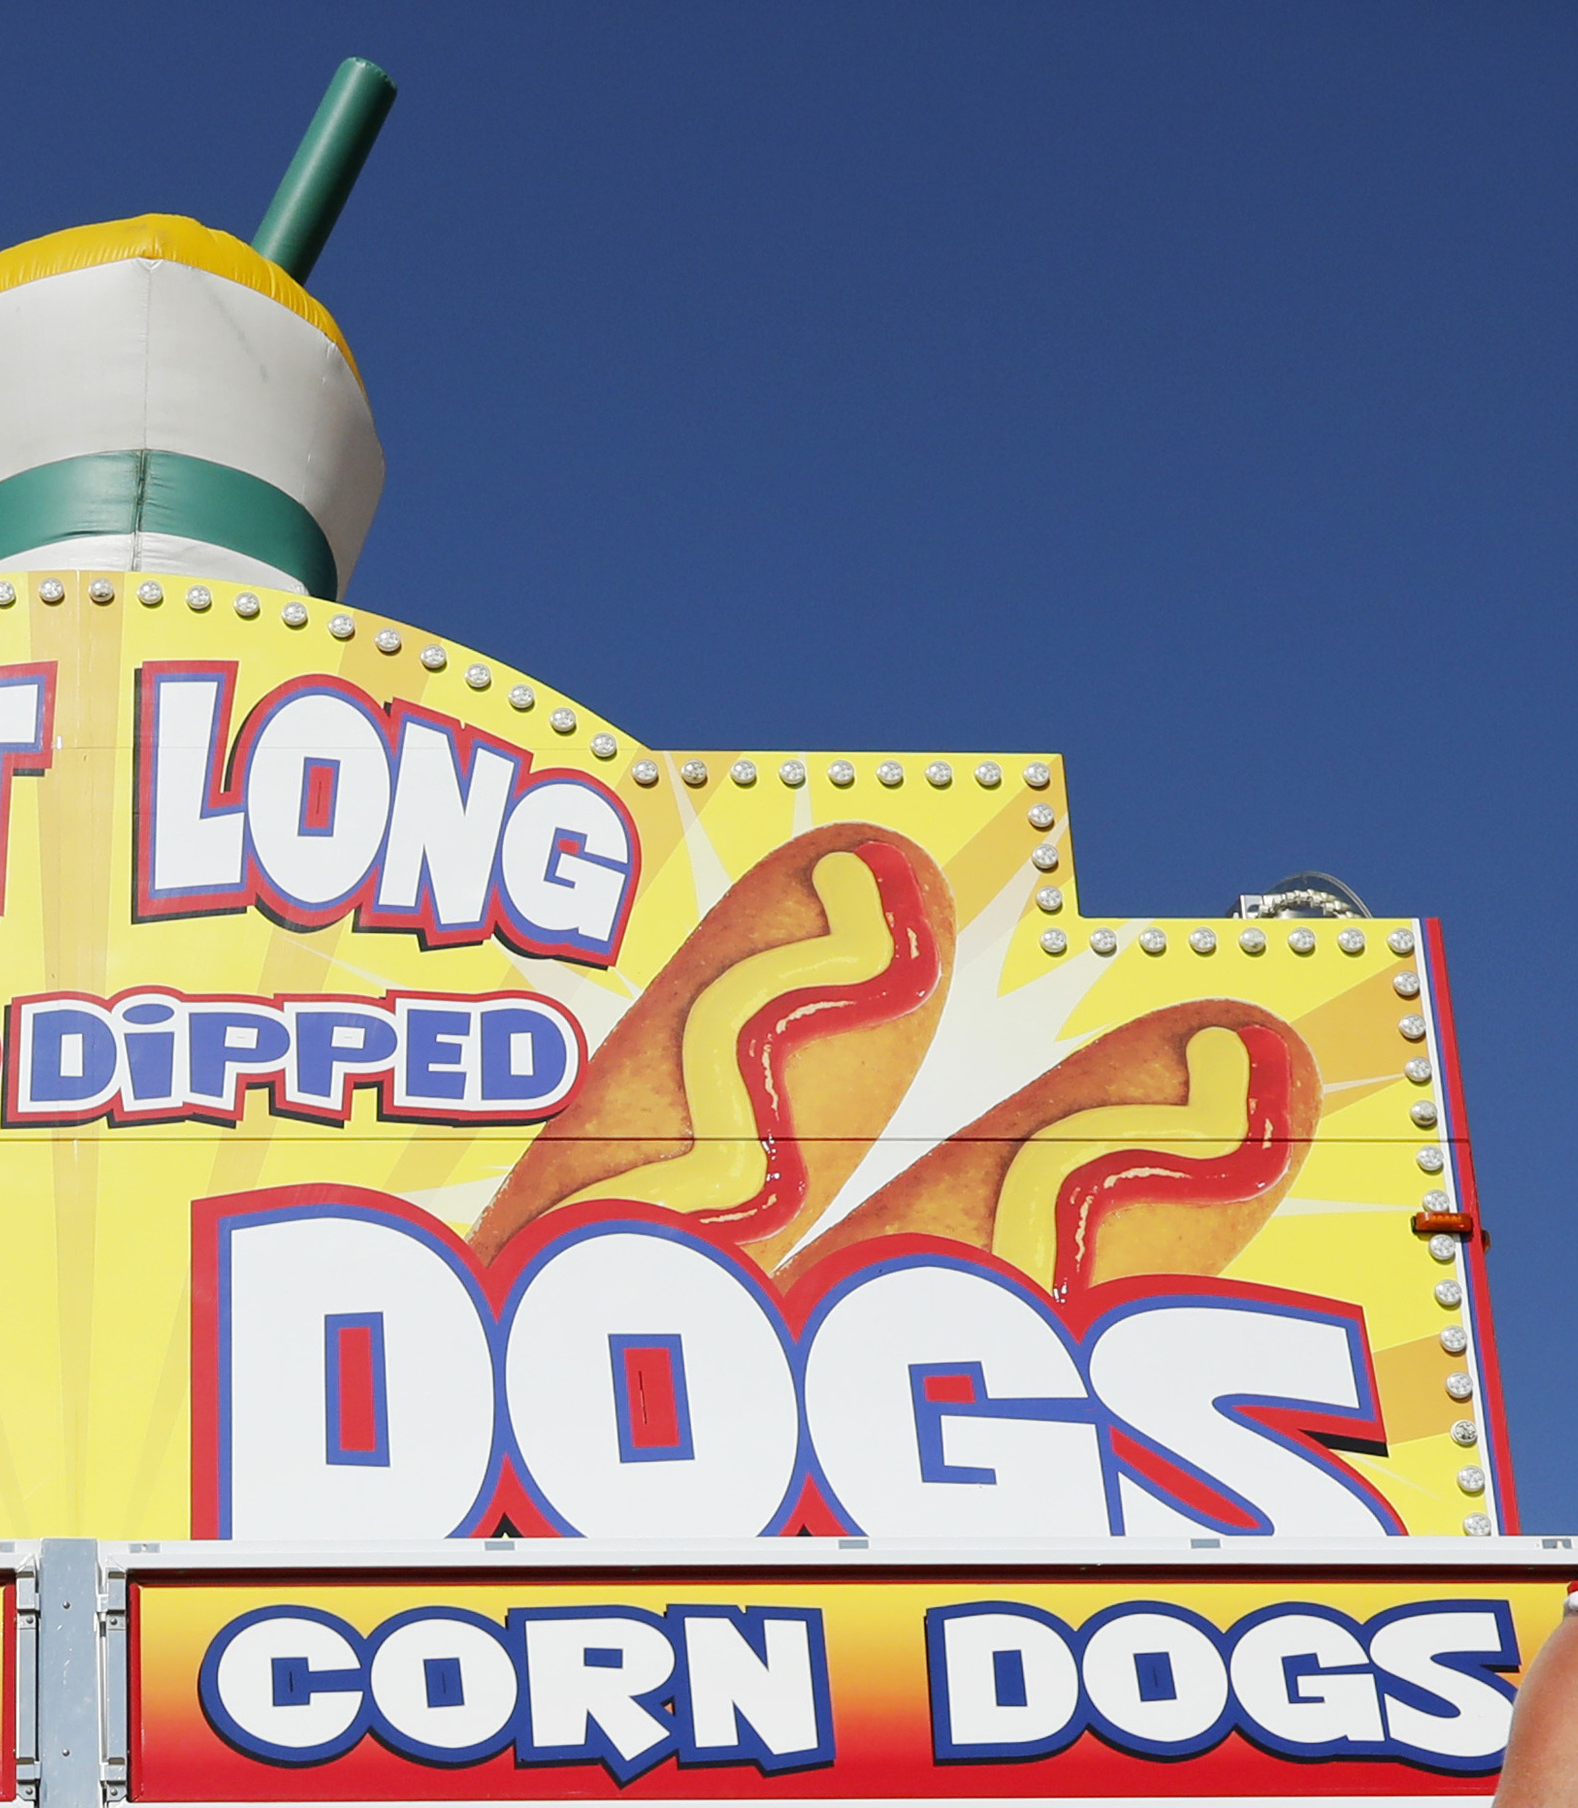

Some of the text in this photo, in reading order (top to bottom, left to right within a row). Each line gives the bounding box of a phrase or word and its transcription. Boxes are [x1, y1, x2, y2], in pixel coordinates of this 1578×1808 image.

[135, 660, 642, 966] LONG
[193, 1186, 1408, 1540] DOGS
[200, 1604, 836, 1785] CORN
[924, 1599, 1521, 1778] DOGS
